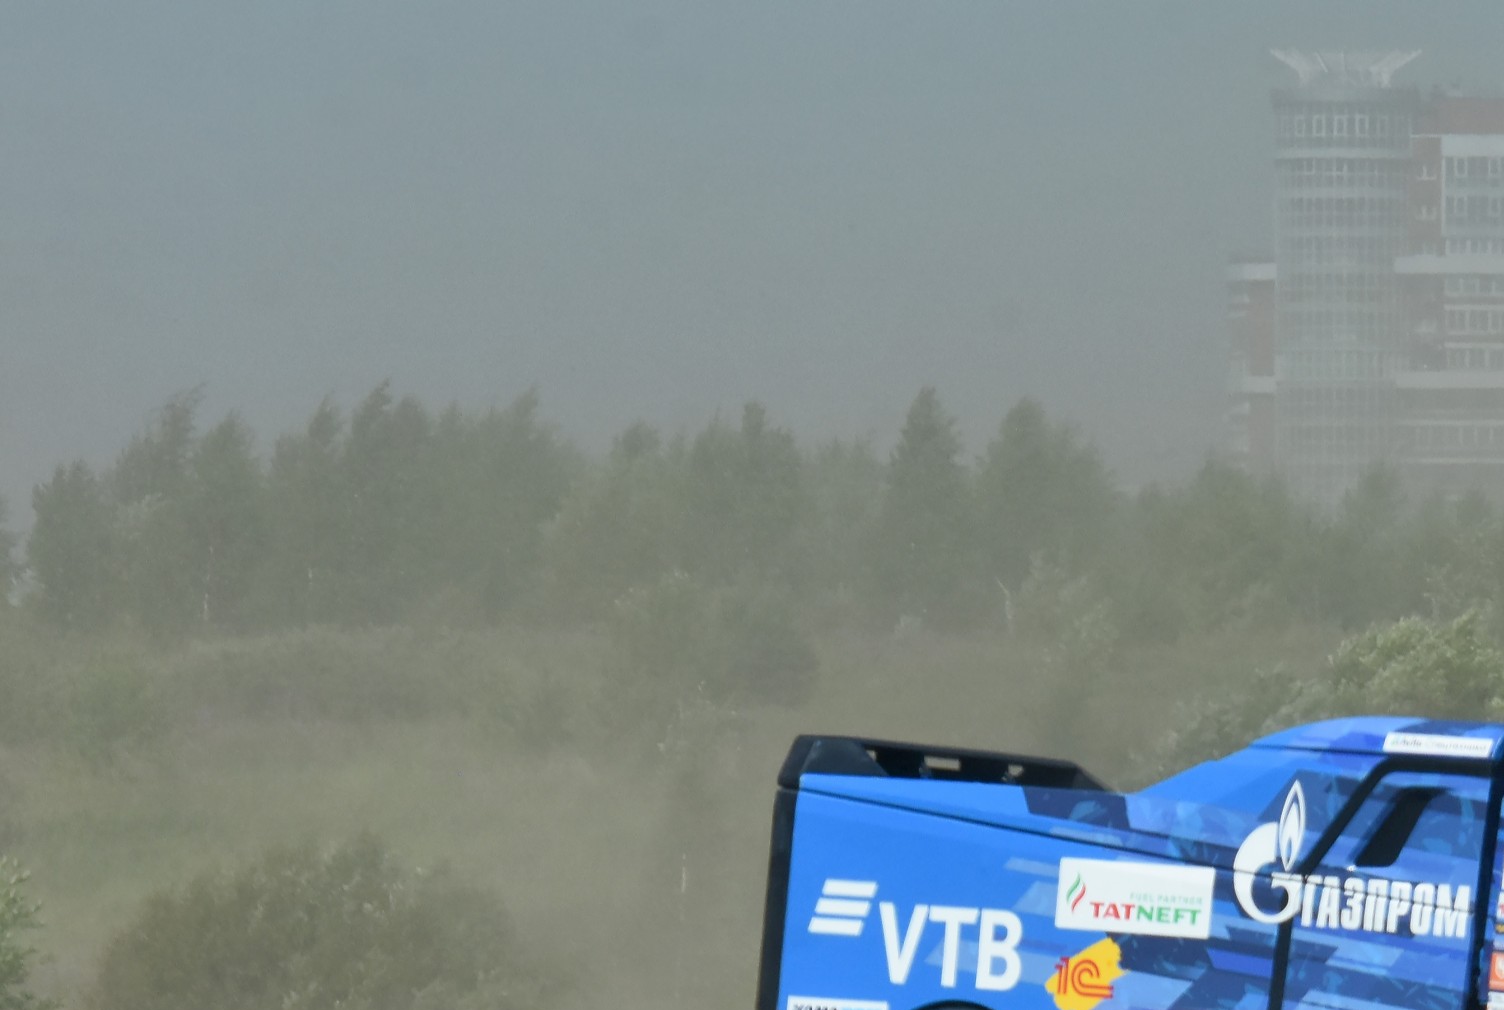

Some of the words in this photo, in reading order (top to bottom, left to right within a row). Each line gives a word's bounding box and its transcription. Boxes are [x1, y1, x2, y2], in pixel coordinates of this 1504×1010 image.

[1090, 901, 1201, 925] TATNEFT
[1301, 875, 1470, 938] ГАЗПРОМ
[879, 901, 1023, 991] VTB
